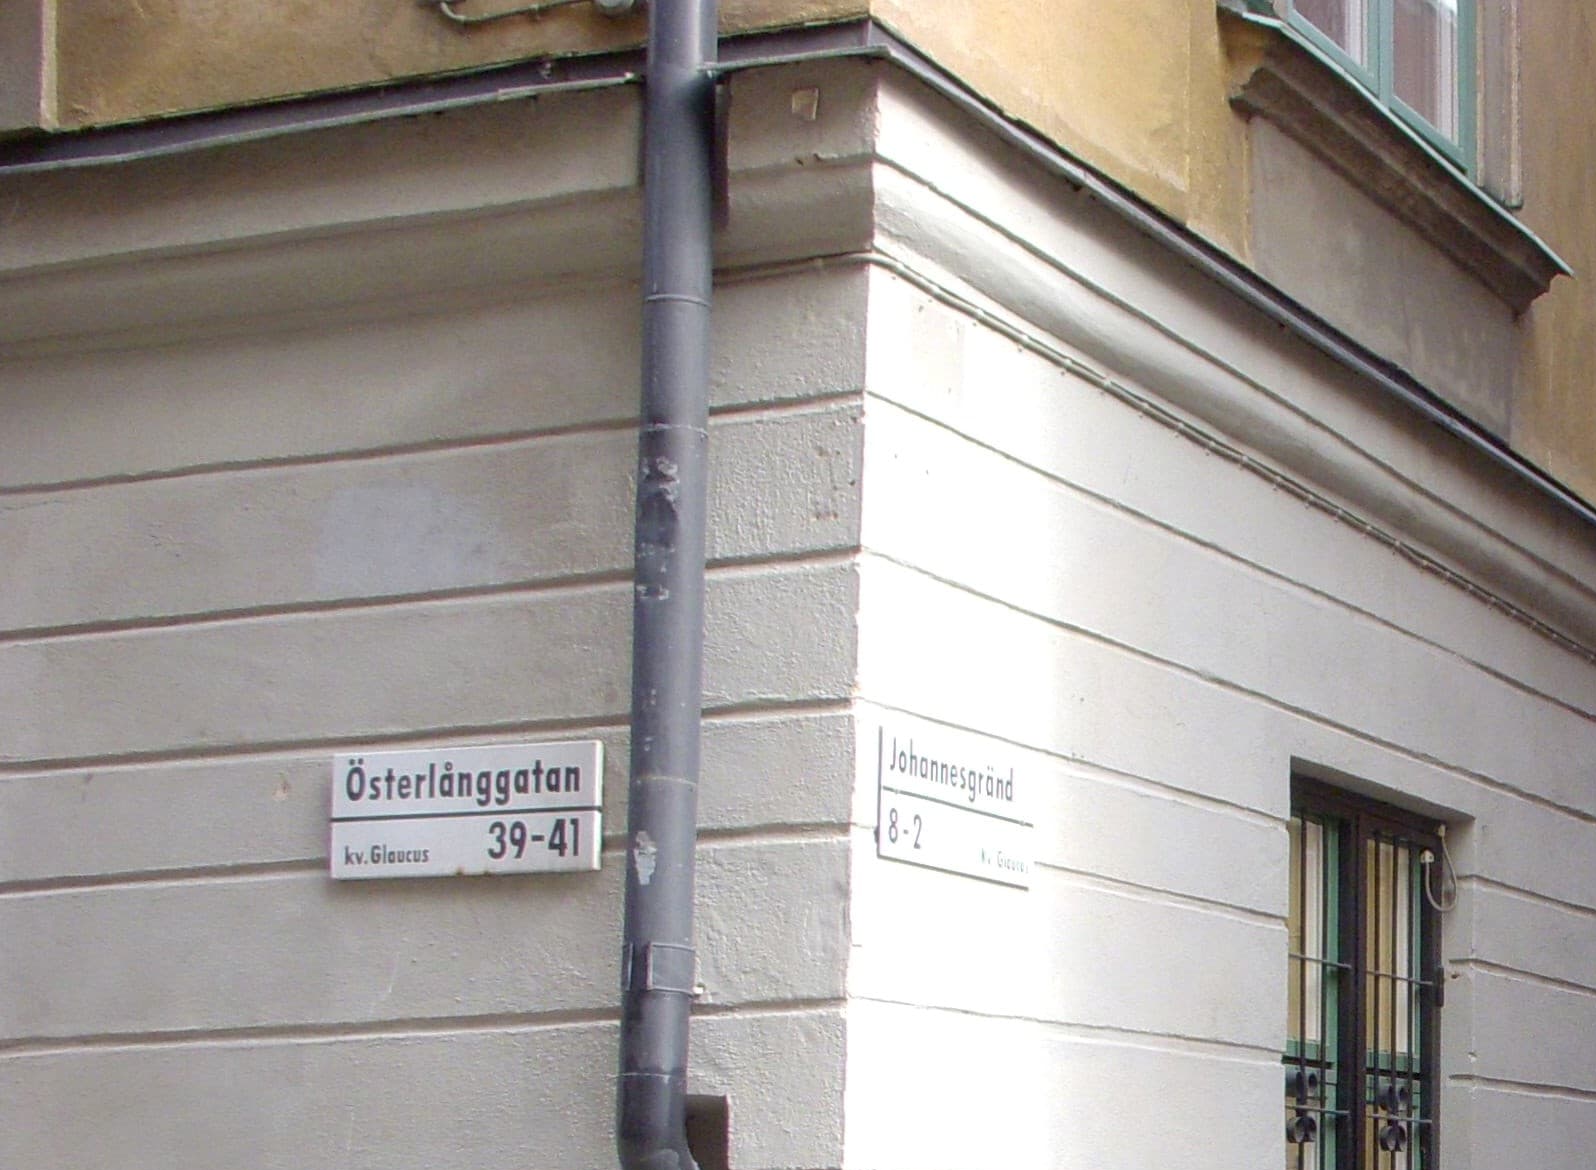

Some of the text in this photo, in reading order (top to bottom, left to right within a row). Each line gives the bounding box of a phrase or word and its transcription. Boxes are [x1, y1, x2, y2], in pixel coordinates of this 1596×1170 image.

[345, 758, 581, 807] Österlånggatan
[890, 737, 1014, 802] Johannesgränd
[370, 845, 430, 864] Glaucus
[487, 818, 581, 860] 39-41
